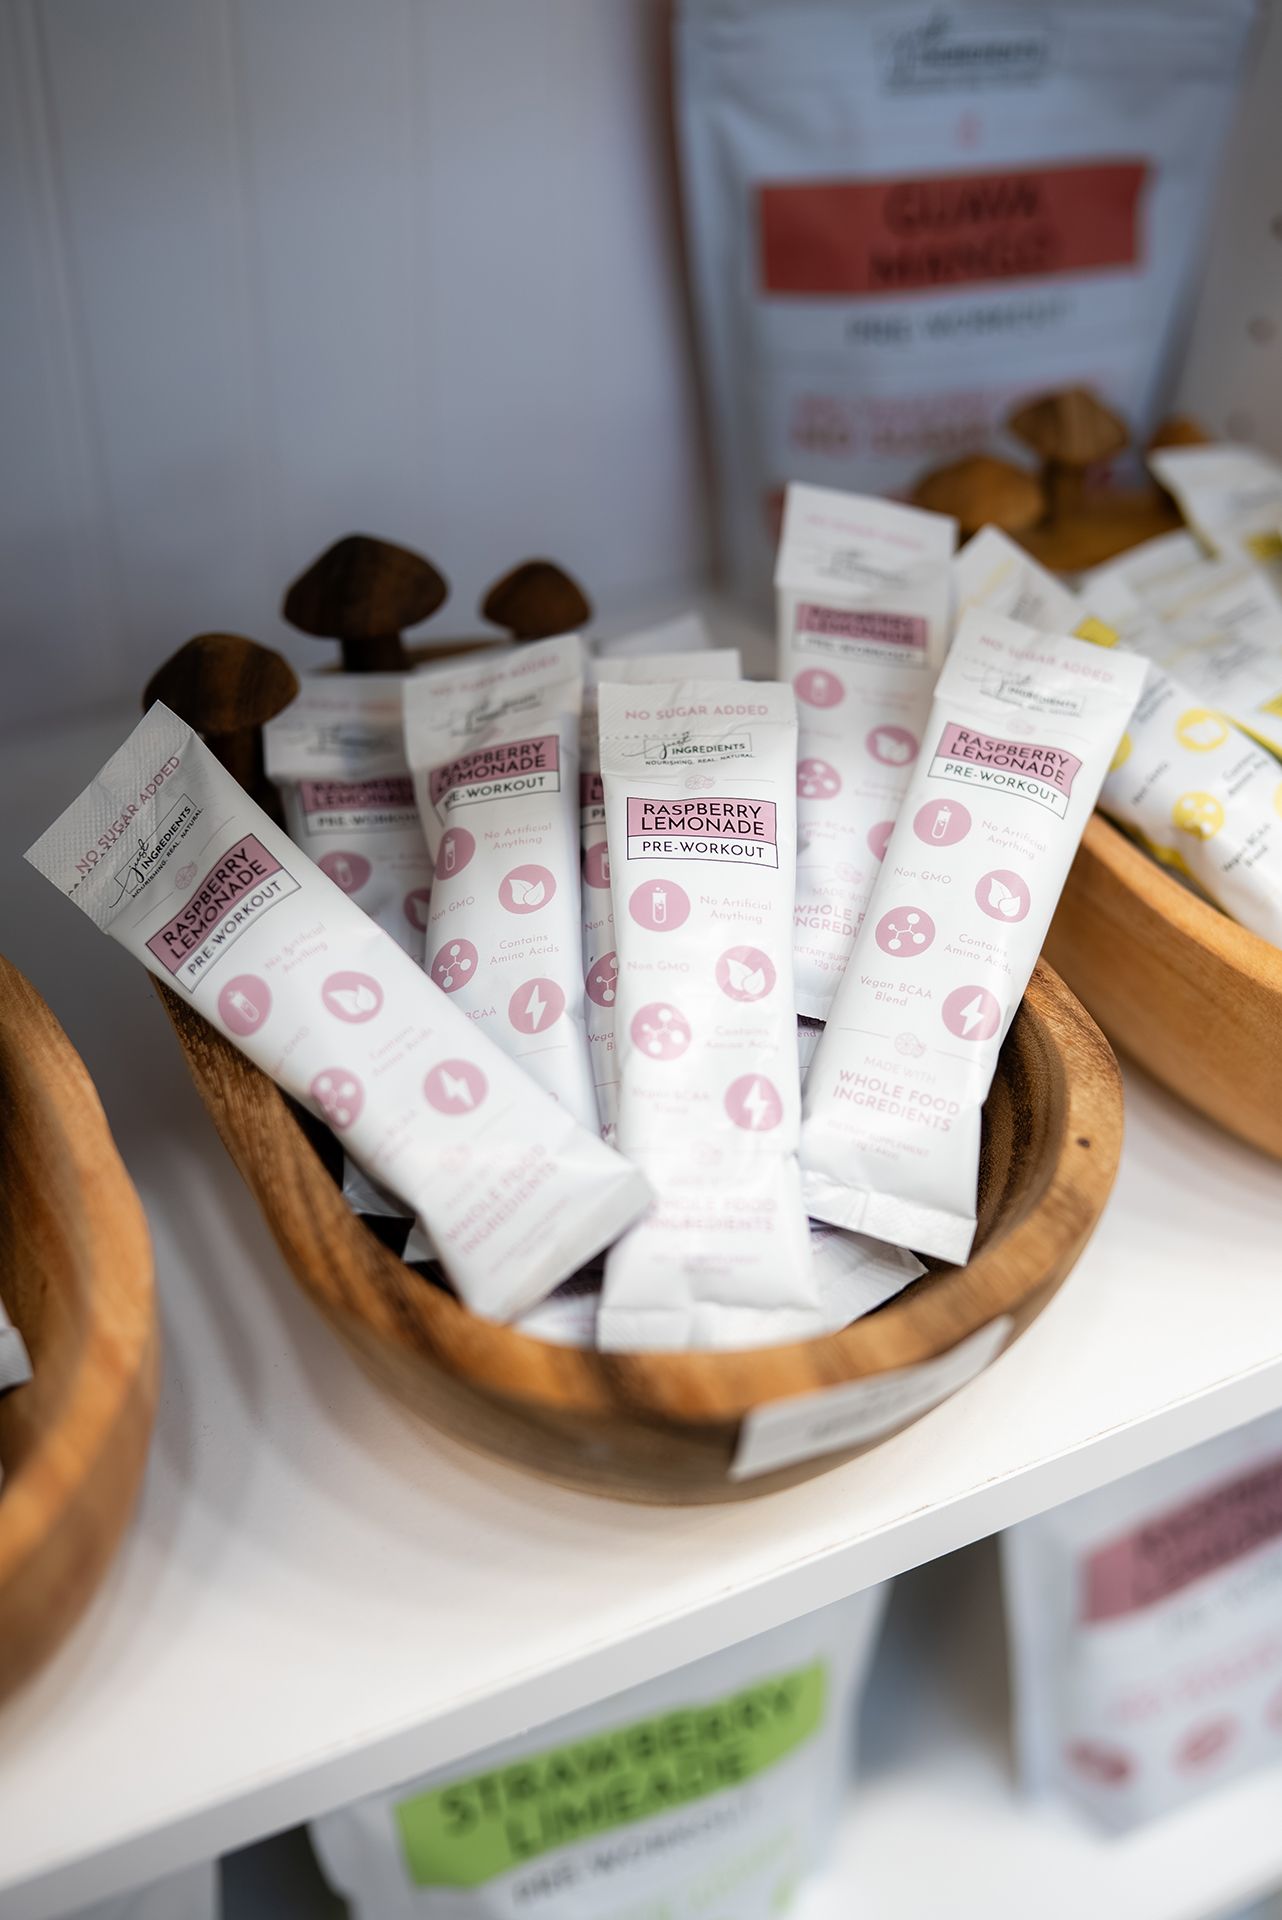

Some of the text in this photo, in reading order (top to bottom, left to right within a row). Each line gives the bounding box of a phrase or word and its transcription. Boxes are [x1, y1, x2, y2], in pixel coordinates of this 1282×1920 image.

[980, 635, 1003, 652] NO
[1062, 660, 1115, 683] ADDED
[624, 704, 770, 721] NO SUGAR ADDED
[671, 742, 746, 756] INGREDIENTS
[957, 731, 1070, 768] RASPBERRY
[440, 743, 545, 779] RASPBERRY
[950, 742, 1065, 786] LEMONADE
[944, 763, 1059, 805] PRE-WORKOUT
[75, 756, 181, 874] NO SUGAR ADDED
[643, 802, 762, 819] RASPBERRY
[141, 806, 192, 870] INGREDIENTS
[484, 823, 553, 841] No Artificial
[641, 816, 765, 837] LEMONADE
[982, 819, 1048, 854] No Artificial
[493, 836, 543, 850] Anything
[642, 841, 765, 859] PRE-WORKOUT
[986, 834, 1036, 861] Anything
[131, 860, 169, 899] NOURISHING.
[894, 867, 952, 885] Non GMO
[162, 847, 253, 947] RASPBERRY
[700, 895, 772, 911] No Artificial
[170, 858, 268, 960] LEMONADE
[431, 895, 476, 923] Non GMO
[709, 909, 763, 925] Anything
[794, 903, 853, 921] WHOLE
[187, 880, 284, 976] PRE-WORKOUT
[585, 920, 604, 932] Non
[499, 933, 550, 951] Contains
[943, 943, 981, 961] Amino
[489, 944, 561, 967] Amino Acids
[656, 960, 691, 973] GMO
[860, 975, 933, 1000] Vegan BCAA
[875, 991, 908, 1007] Blend
[587, 1030, 615, 1043] Vega
[839, 1069, 961, 1117] WHOLE FOOD
[832, 1085, 953, 1133] INGREDIENTS
